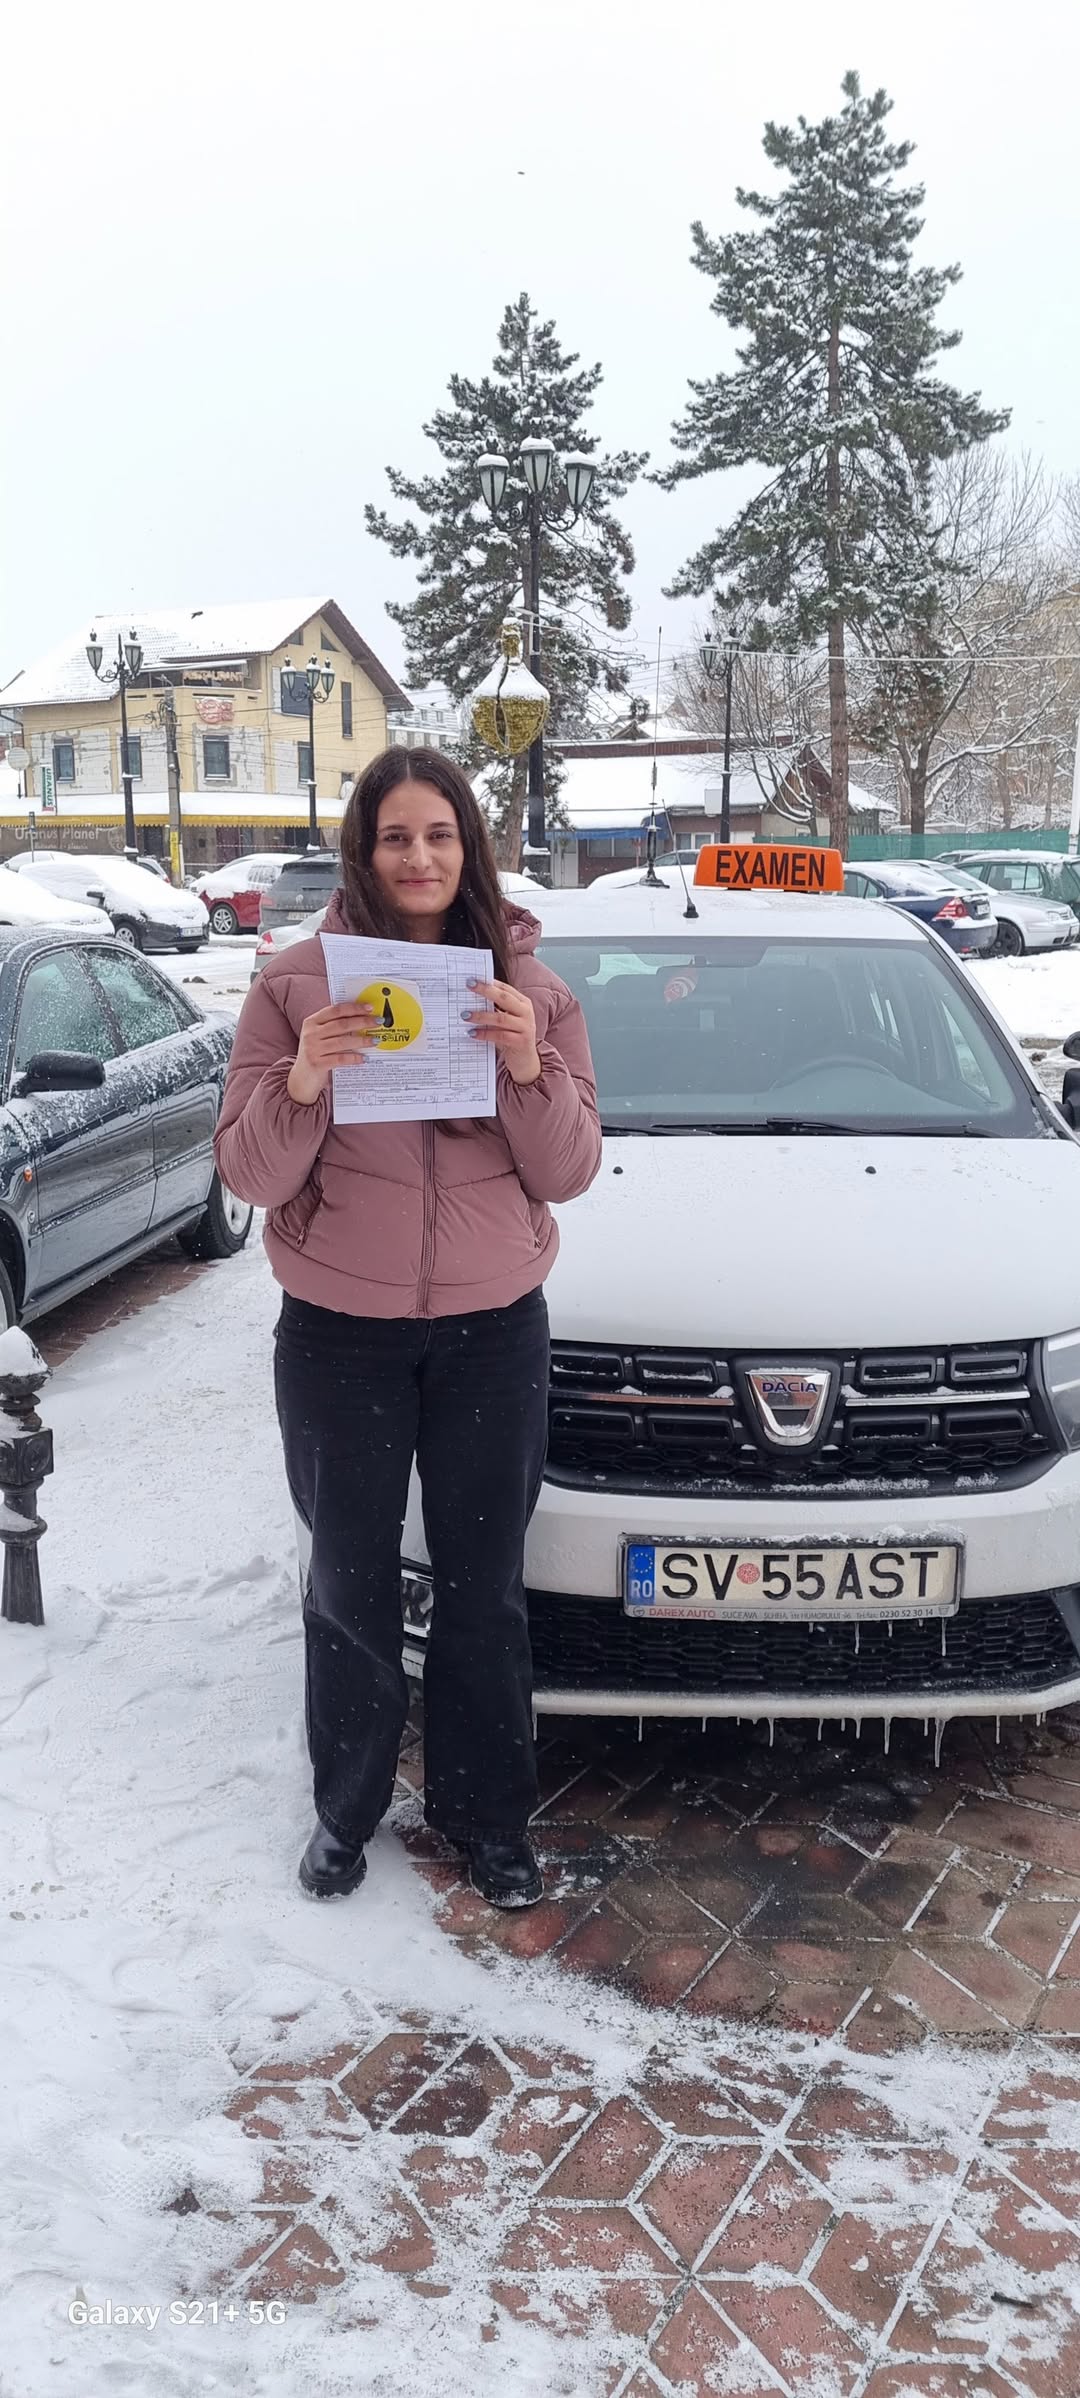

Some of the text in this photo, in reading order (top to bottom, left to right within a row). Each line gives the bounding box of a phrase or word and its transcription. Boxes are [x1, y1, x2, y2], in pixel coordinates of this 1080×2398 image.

[715, 850, 826, 888] EXAMEN
[762, 1382, 818, 1392] DACIA
[662, 1553, 739, 1601] SV
[762, 1554, 826, 1601] 55
[835, 1551, 939, 1600] AST
[631, 1579, 653, 1598] RO
[649, 1608, 685, 1617] DAREX
[687, 1609, 716, 1618] AUTO
[722, 1611, 758, 1619] SUCEAVA
[879, 1610, 899, 1618] 0230
[913, 1609, 923, 1617] 30
